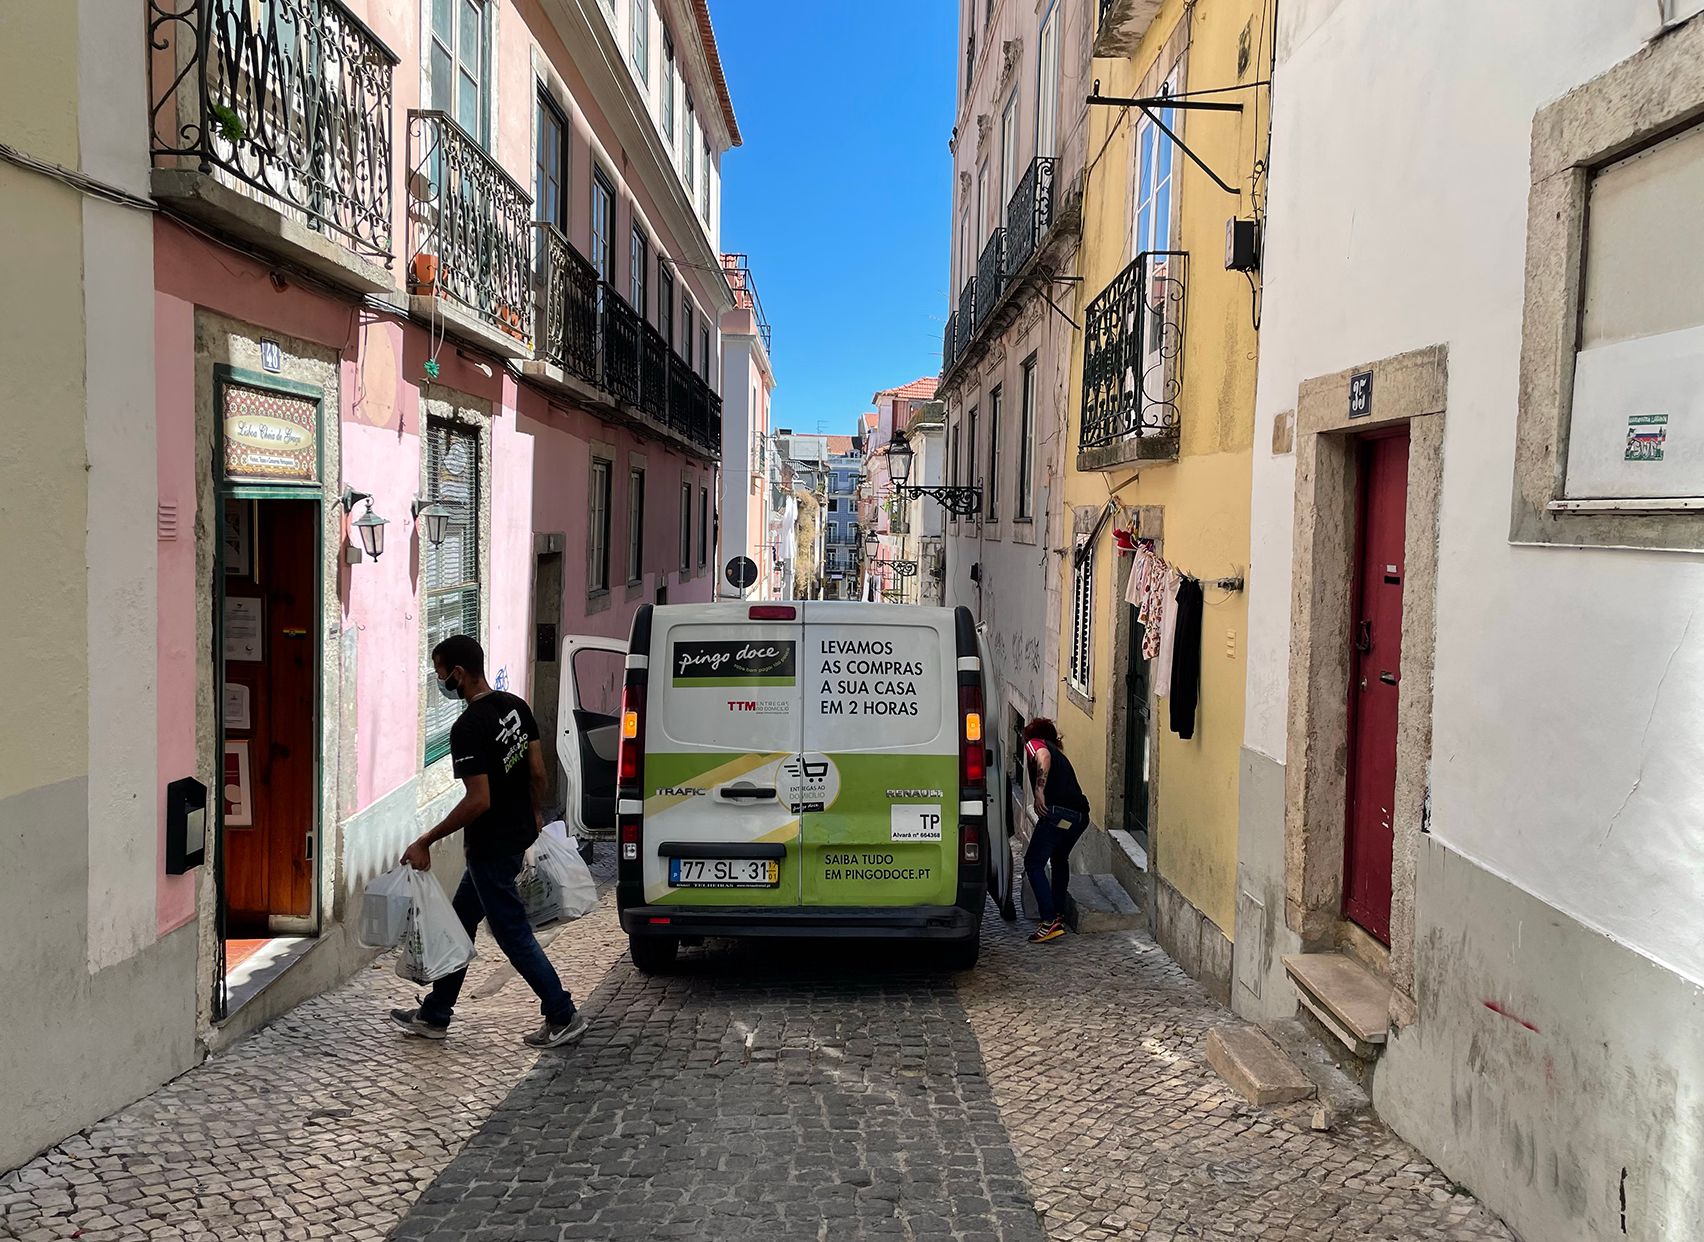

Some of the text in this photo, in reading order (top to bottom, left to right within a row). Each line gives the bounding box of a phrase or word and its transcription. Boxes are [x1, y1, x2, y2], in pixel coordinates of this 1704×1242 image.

[265, 343, 279, 369] 48
[1352, 379, 1367, 411] 35
[821, 640, 893, 655] LEVAMOS
[679, 644, 780, 675] pingo doce
[820, 660, 923, 676] AS COMPRAS
[820, 680, 917, 696] A SUA CASA
[727, 701, 757, 712] TTM
[821, 700, 919, 716] EM 2 HORAS
[655, 786, 706, 796] TRAFIC
[886, 788, 944, 798] RENAULT
[919, 814, 940, 830] TP
[825, 854, 894, 865] SAIBA TUDO
[825, 868, 931, 880] EM PINGODOCE.PT
